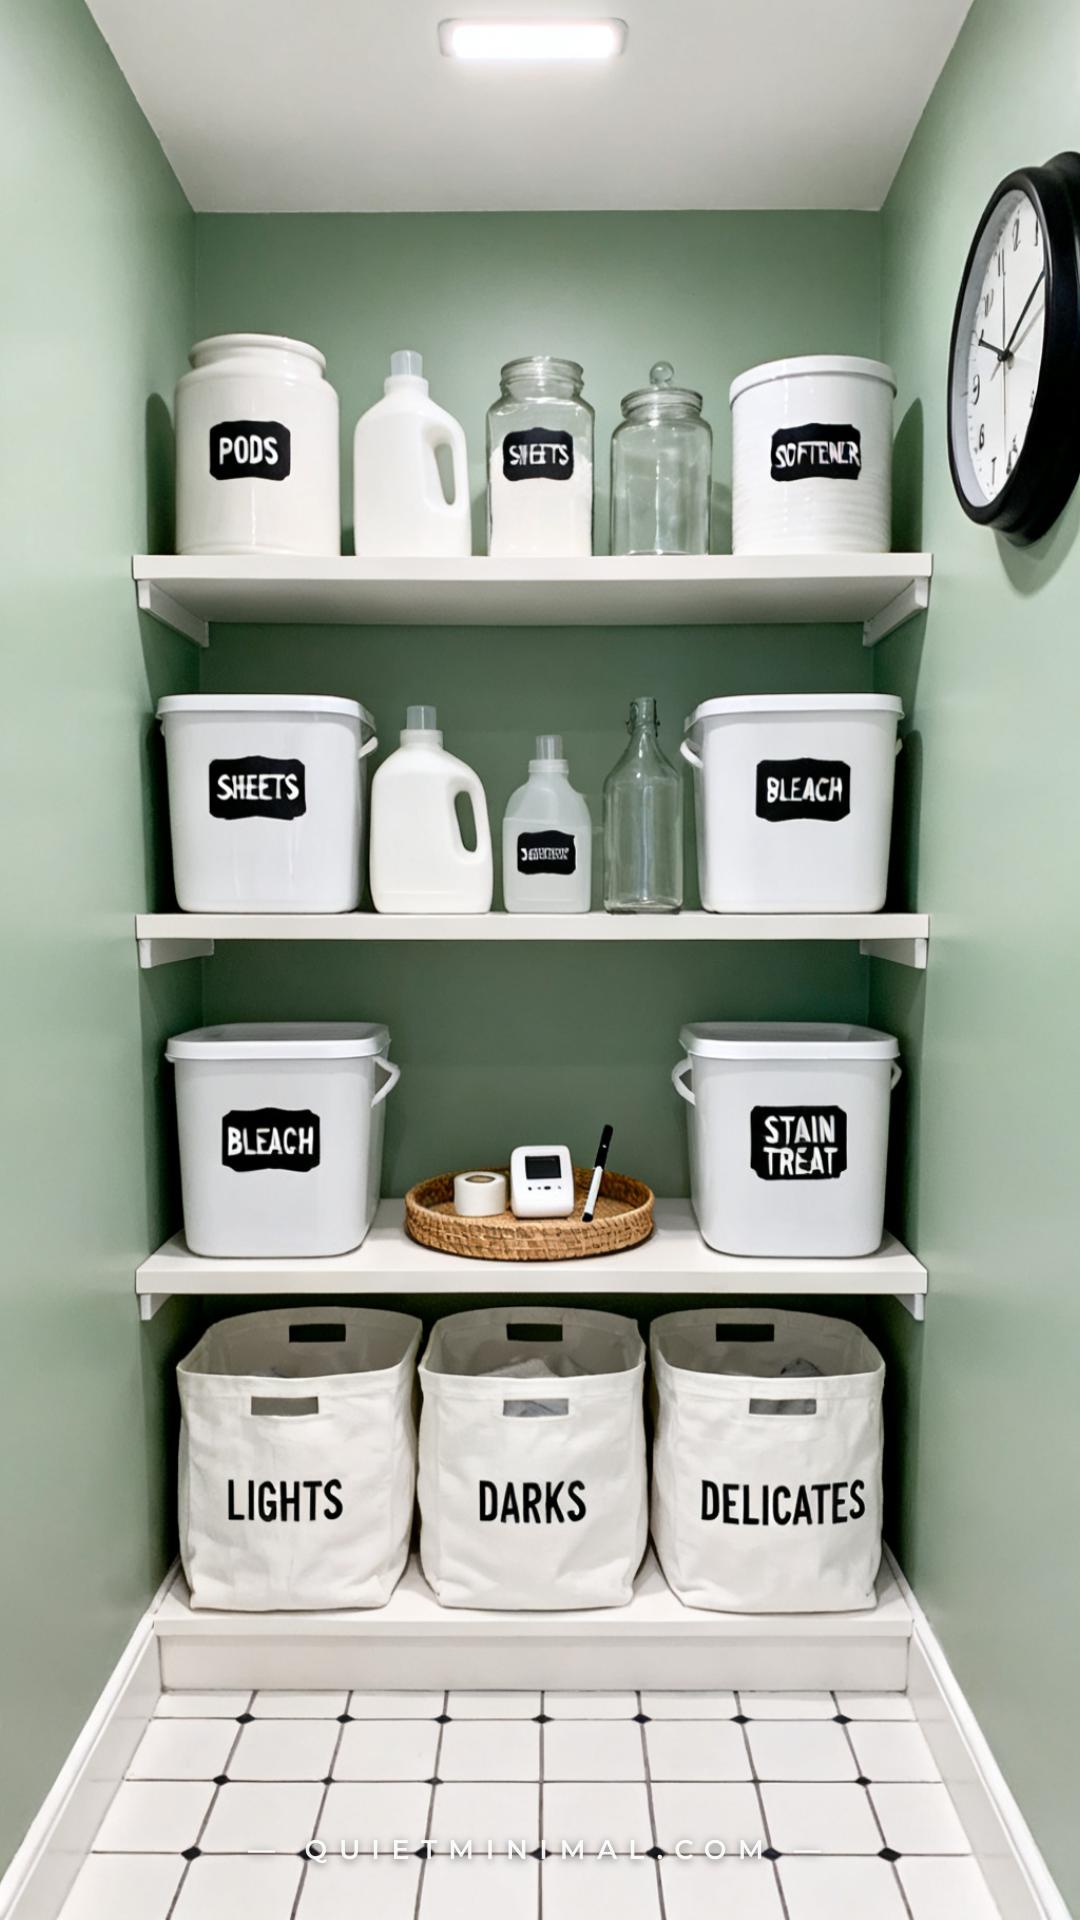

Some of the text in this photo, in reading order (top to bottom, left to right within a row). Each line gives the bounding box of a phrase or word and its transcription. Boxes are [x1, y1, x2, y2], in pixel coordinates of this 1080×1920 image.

[219, 434, 279, 466] PODS
[216, 772, 301, 806] SHEETS
[766, 776, 844, 804] BLEACH
[227, 1126, 314, 1156] BLEACH
[763, 1114, 836, 1145] STAIN
[762, 1146, 839, 1176] TREAT
[227, 1478, 343, 1523] LIGHTS
[479, 1480, 587, 1524] DARKS
[701, 1479, 866, 1526] DELICATES
